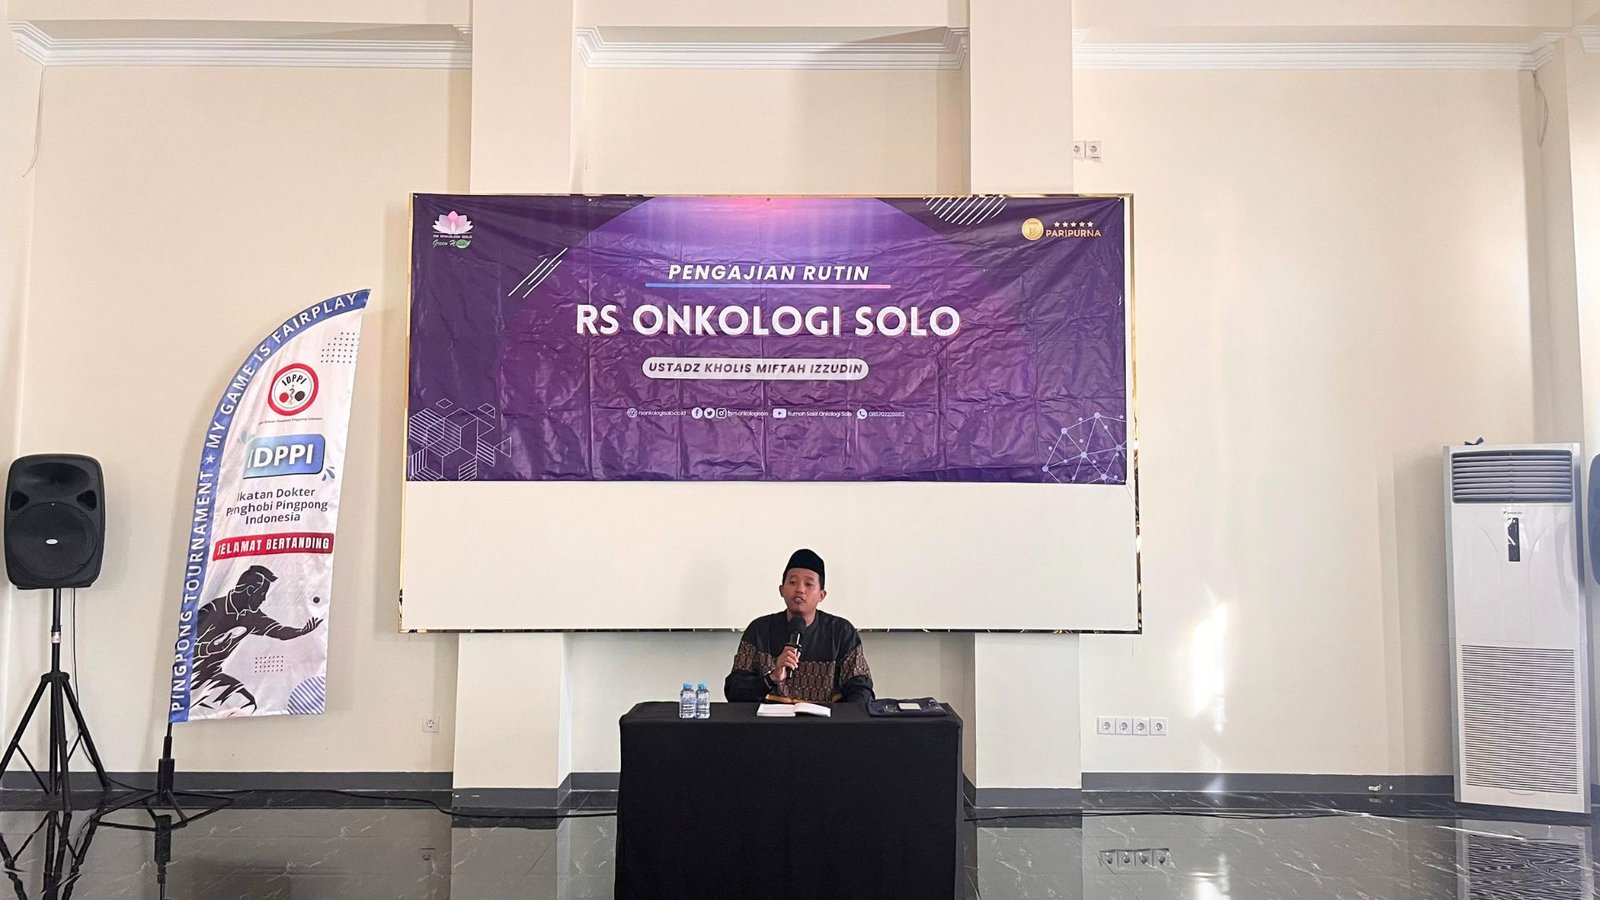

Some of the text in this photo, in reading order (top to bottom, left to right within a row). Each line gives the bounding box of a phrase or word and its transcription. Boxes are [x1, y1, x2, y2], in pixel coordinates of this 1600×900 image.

[1045, 229, 1102, 238] PARIPURNA
[668, 264, 869, 281] PENGAJIAN RUTIN
[576, 304, 961, 337] RS ONKOLOGI SOLO
[648, 362, 863, 374] USTADZ KHOLIS MIFTAH IZZUDIN
[281, 374, 307, 387] IDPPI
[247, 443, 314, 469] IDPPI
[237, 487, 316, 502] Ikatan Dokter
[171, 293, 358, 712] PINGPONG TOURNAMENT MY GAME IS FAIRPLAY
[276, 500, 329, 512] Pingpong
[245, 511, 301, 525] Indonesia
[265, 536, 330, 551] BERTANDING
